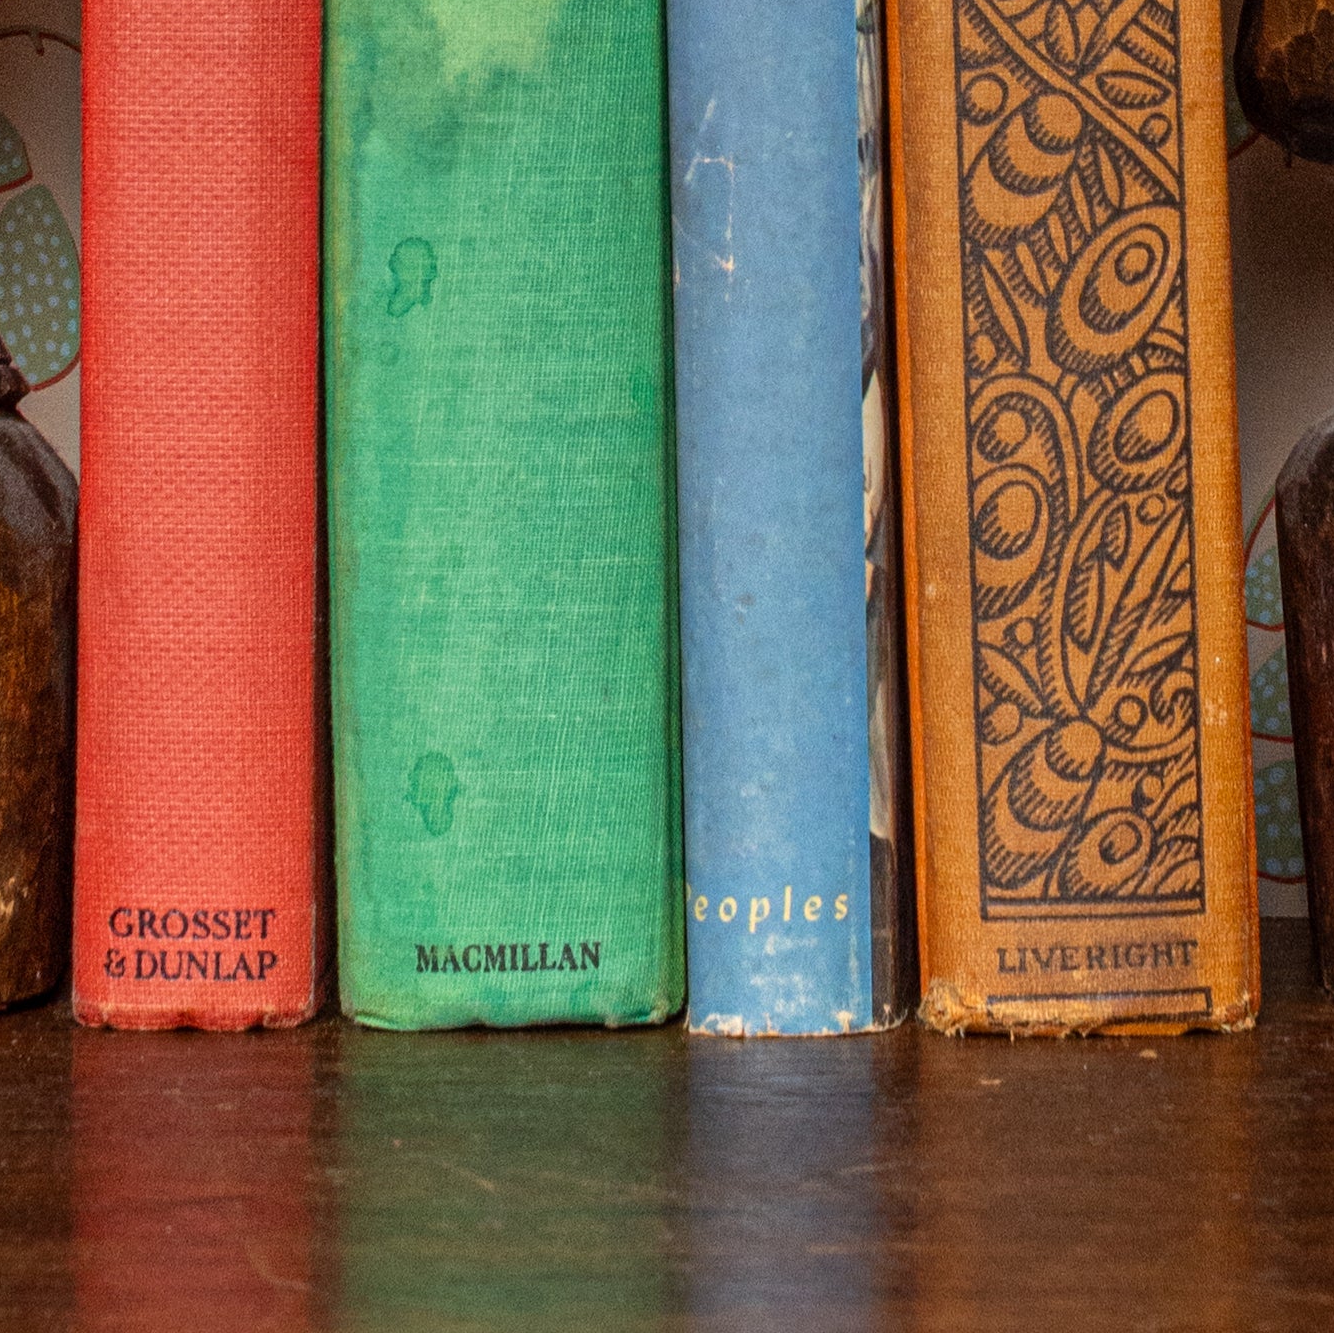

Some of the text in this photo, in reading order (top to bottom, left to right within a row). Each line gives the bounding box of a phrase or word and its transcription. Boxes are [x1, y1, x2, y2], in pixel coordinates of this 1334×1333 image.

[108, 907, 276, 940] GROSSET
[687, 883, 849, 933] eoples
[104, 949, 277, 981] & DUNLAP
[415, 942, 601, 973] MACMILLAN
[997, 939, 1199, 975] LIVERIGHT
